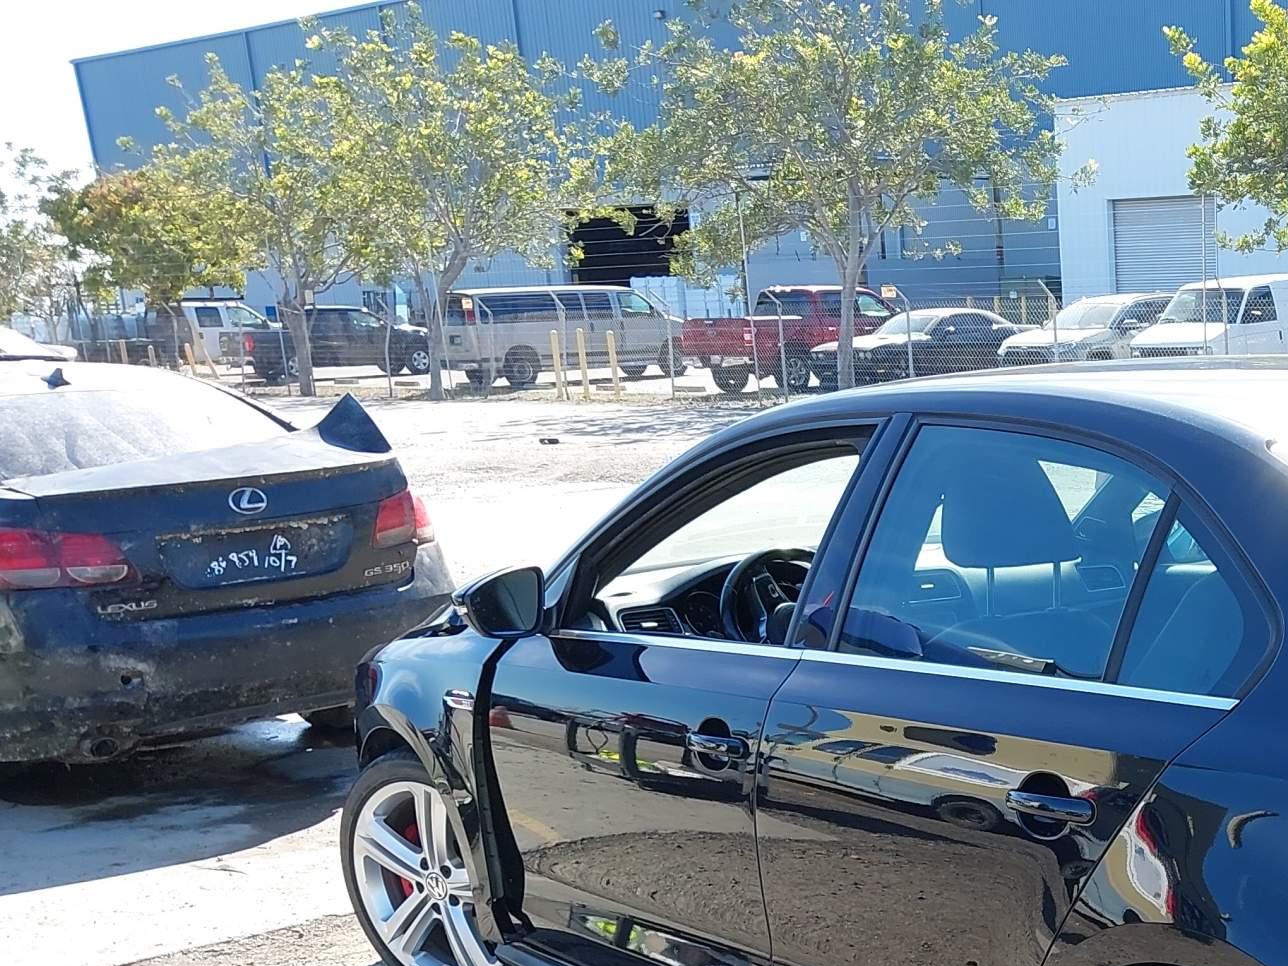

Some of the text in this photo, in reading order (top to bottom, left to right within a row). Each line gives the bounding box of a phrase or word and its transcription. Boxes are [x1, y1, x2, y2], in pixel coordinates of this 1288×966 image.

[364, 560, 409, 577] GS 350
[97, 600, 157, 614] LEXUS
